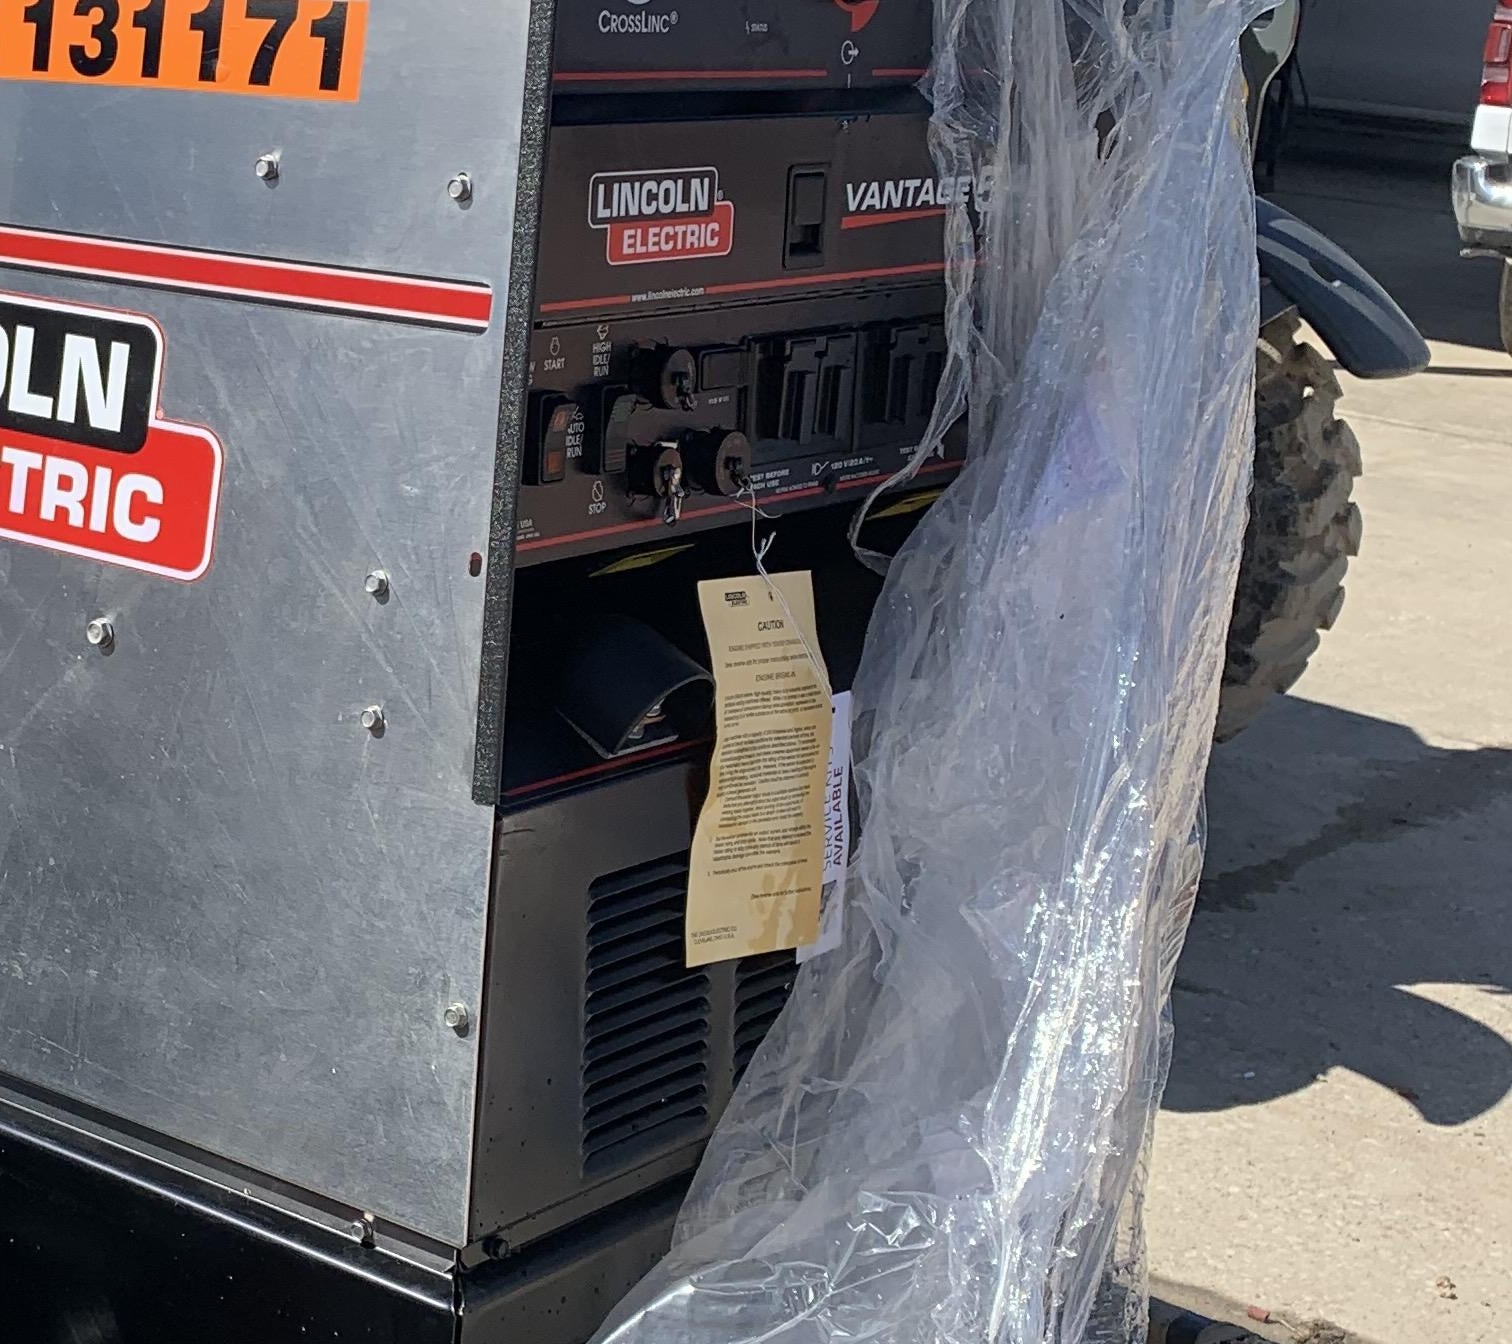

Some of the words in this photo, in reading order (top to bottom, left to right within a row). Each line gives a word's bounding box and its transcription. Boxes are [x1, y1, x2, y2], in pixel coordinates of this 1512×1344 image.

[597, 177, 710, 219] LINCOLN
[846, 175, 972, 212] VANTAGE
[622, 222, 720, 255] ELECTRIC
[592, 342, 612, 353] HIGH
[543, 357, 565, 371] START
[593, 365, 609, 377] RUN
[566, 446, 583, 458] RUN
[589, 501, 607, 515] STOP
[757, 619, 785, 631] CAUTION
[832, 766, 844, 866] AVAILABLE
